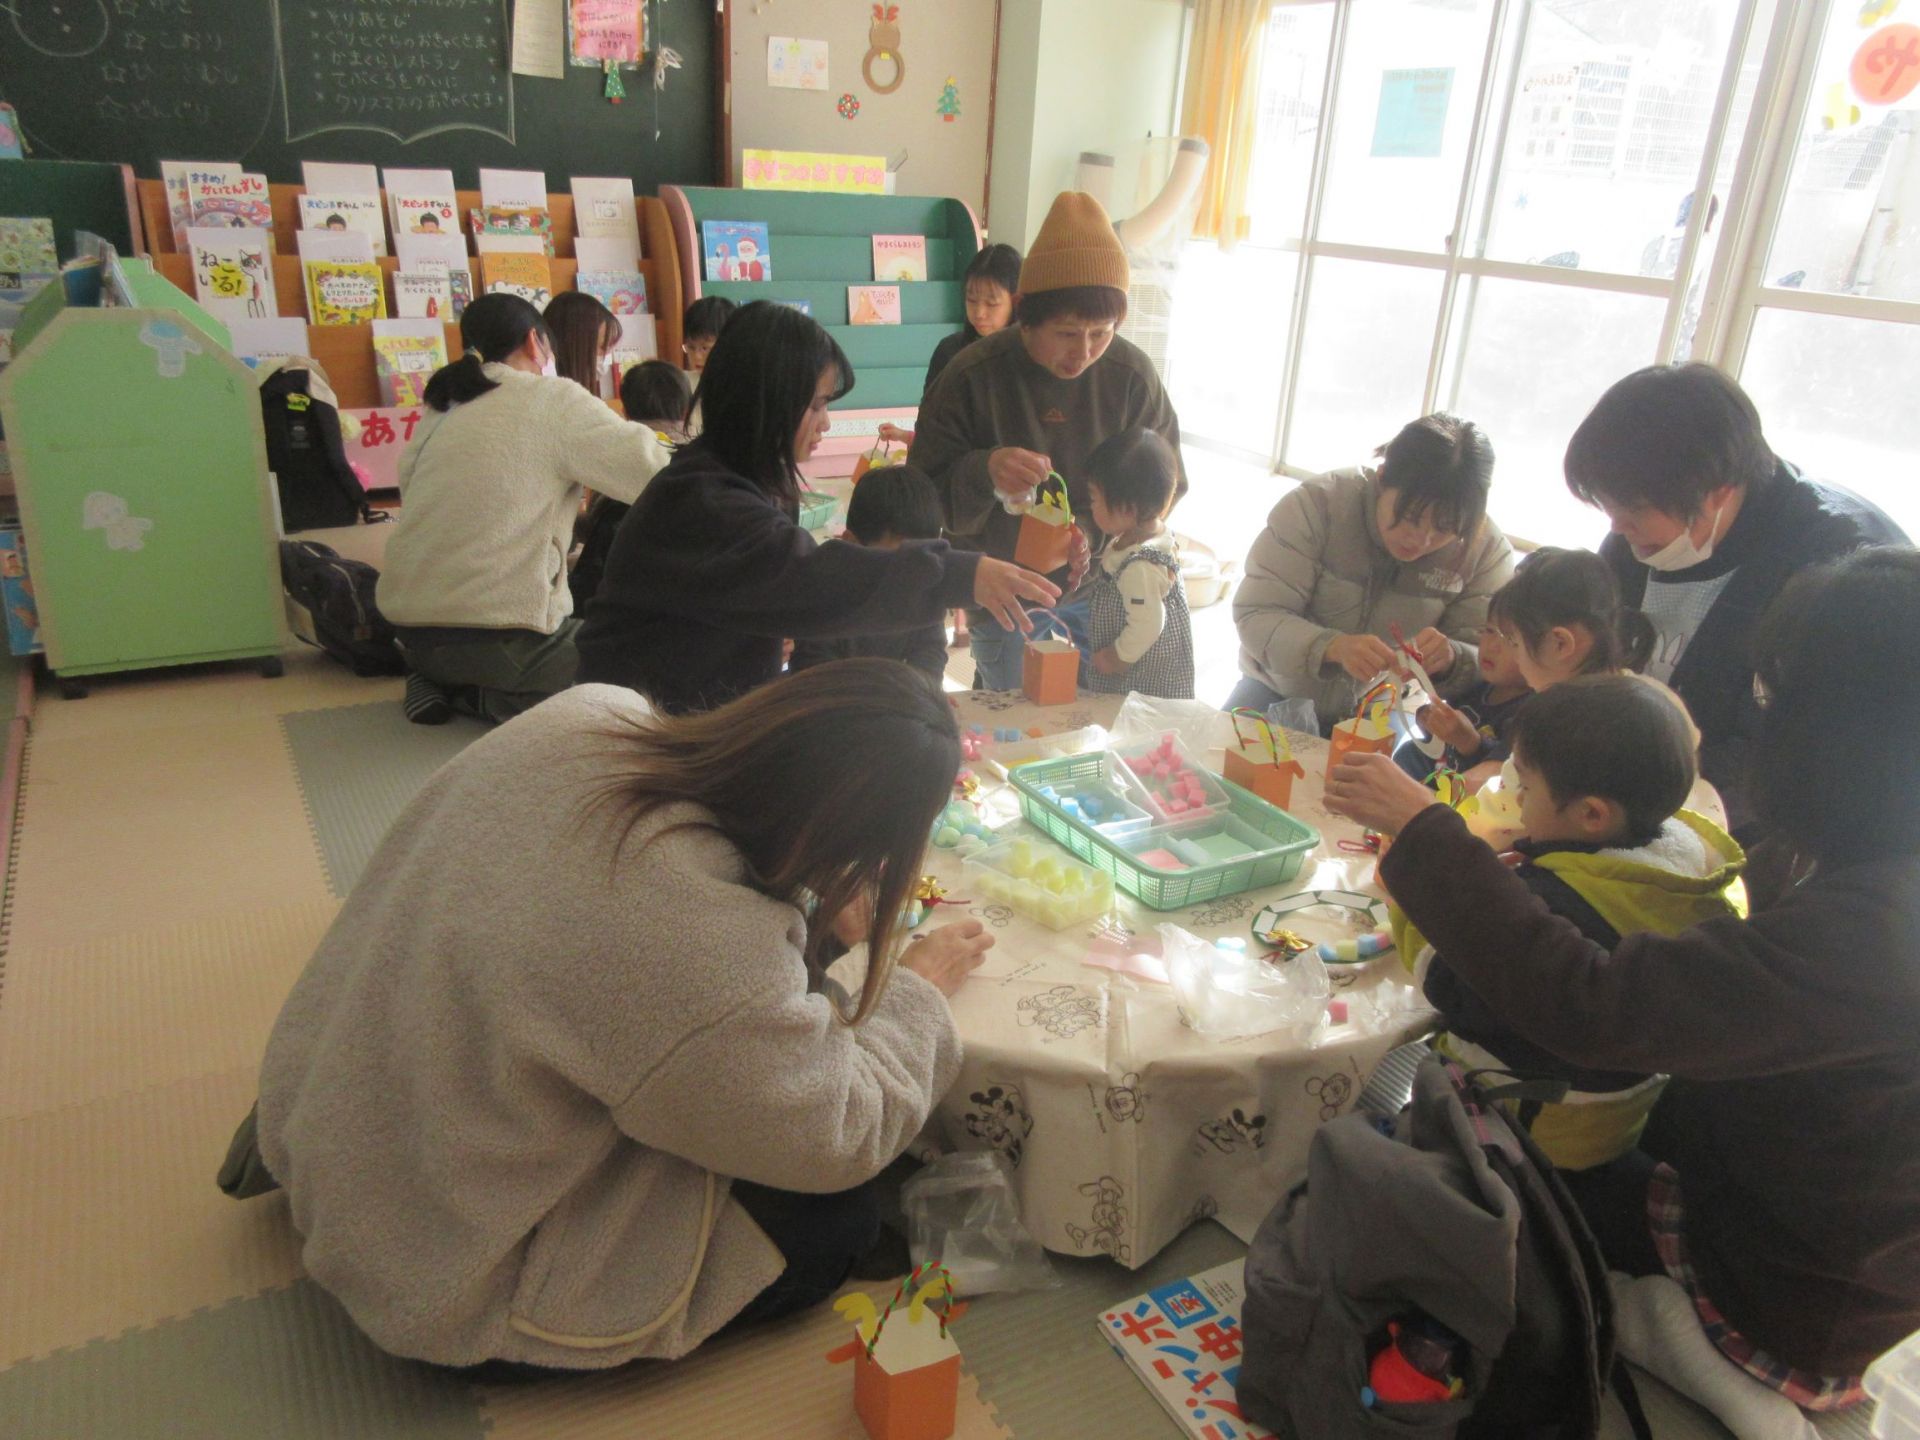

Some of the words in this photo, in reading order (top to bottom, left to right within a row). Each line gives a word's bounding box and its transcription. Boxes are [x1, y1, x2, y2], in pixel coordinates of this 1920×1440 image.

[331, 50, 461, 71] かまくらレストラン
[330, 71, 460, 90] てぶくろをかいに
[335, 91, 492, 113] クリスマスのおきゃくさま
[191, 172, 227, 185] すすめ!
[744, 157, 885, 186] きせつのおすすめ
[200, 177, 263, 196] かいてんずし
[402, 198, 451, 209] 大ピンチずかん
[877, 240, 922, 249] かまくらレストラン
[199, 250, 236, 273] ねこ
[198, 273, 243, 296] いる!
